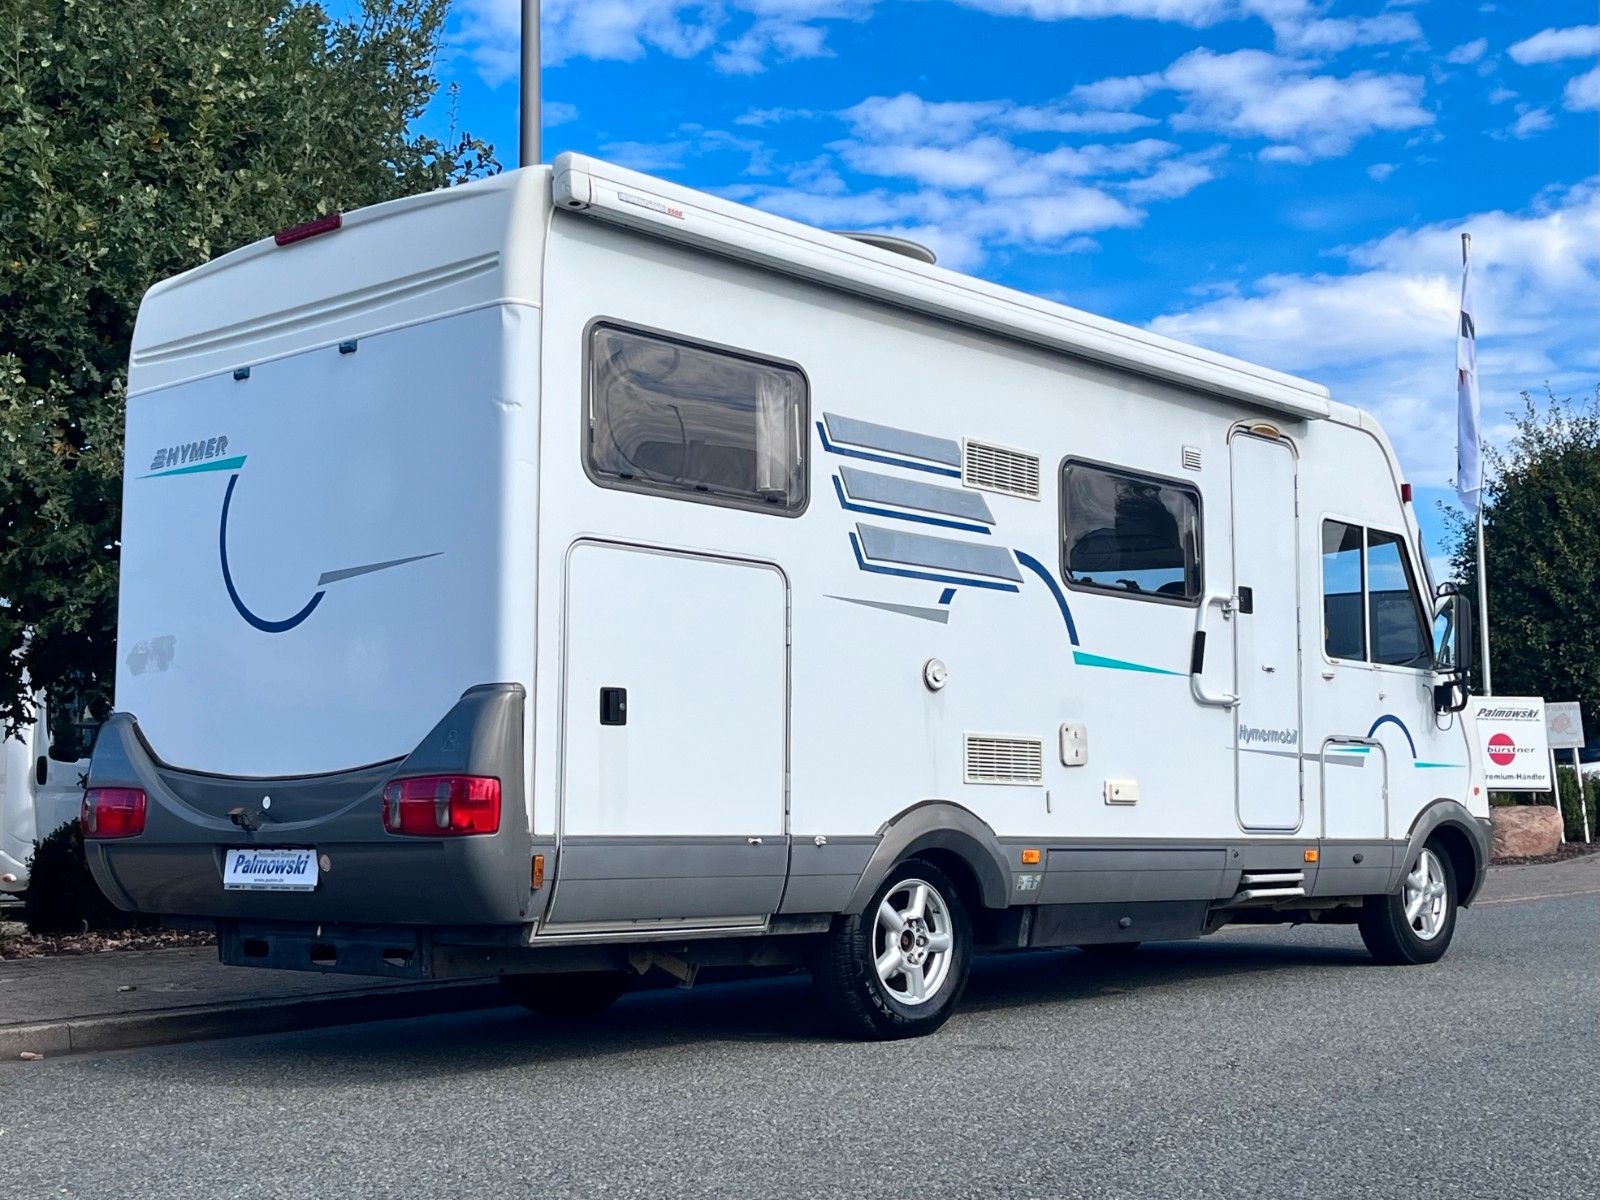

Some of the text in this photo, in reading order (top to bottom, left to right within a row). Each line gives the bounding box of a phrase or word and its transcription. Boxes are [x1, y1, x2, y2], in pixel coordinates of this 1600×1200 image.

[1476, 707, 1540, 718] Palmowski
[1239, 724, 1298, 744] Hymermobil
[1485, 773, 1546, 781] remium-Händler
[233, 854, 310, 875] Palmowski
